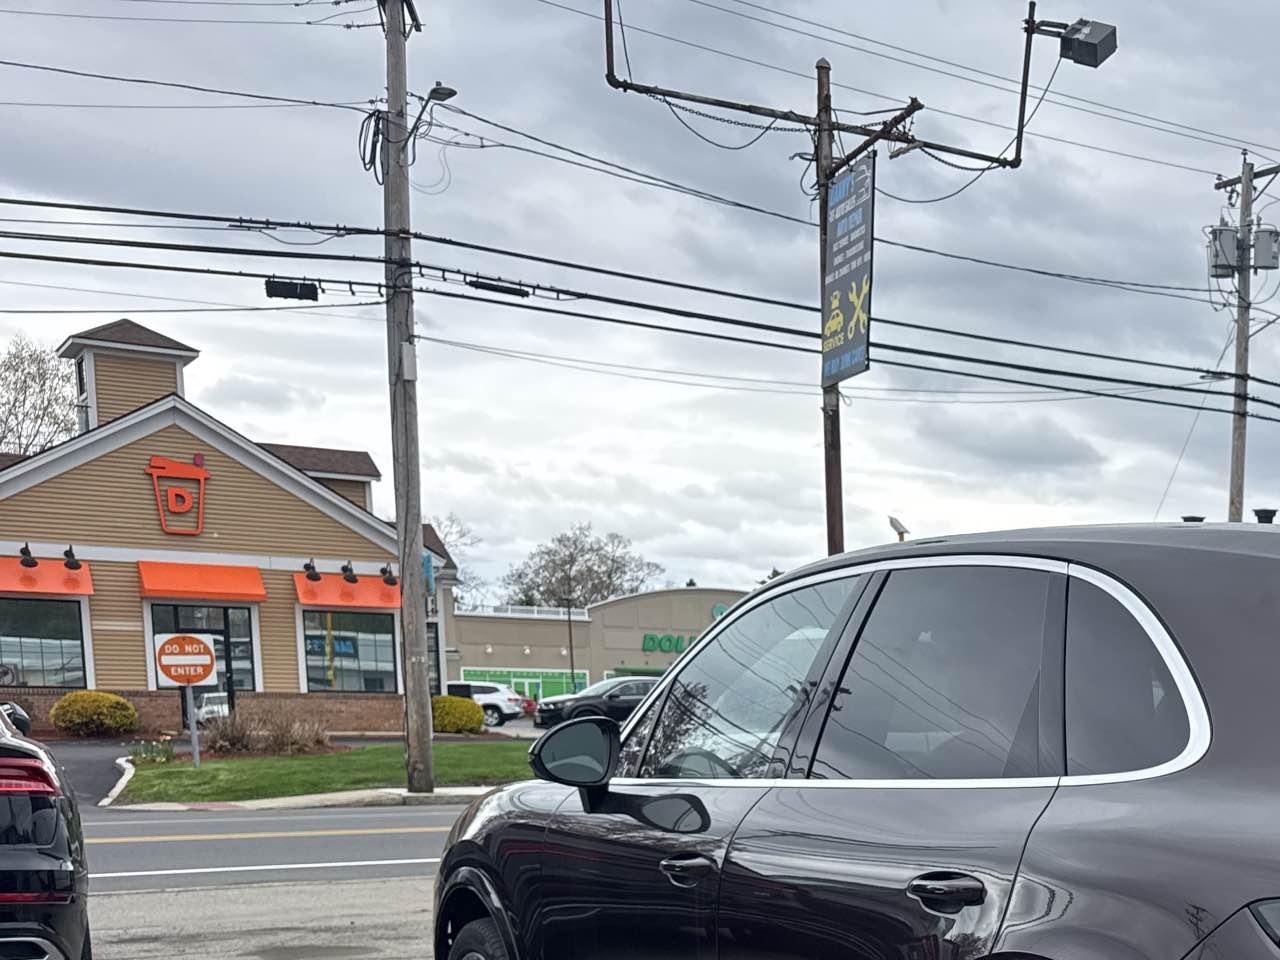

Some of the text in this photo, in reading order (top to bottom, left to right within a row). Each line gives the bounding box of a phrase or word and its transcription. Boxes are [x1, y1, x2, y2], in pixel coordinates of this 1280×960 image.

[167, 486, 193, 513] D
[165, 643, 205, 654] DO NOT
[171, 666, 203, 676] ENTER
